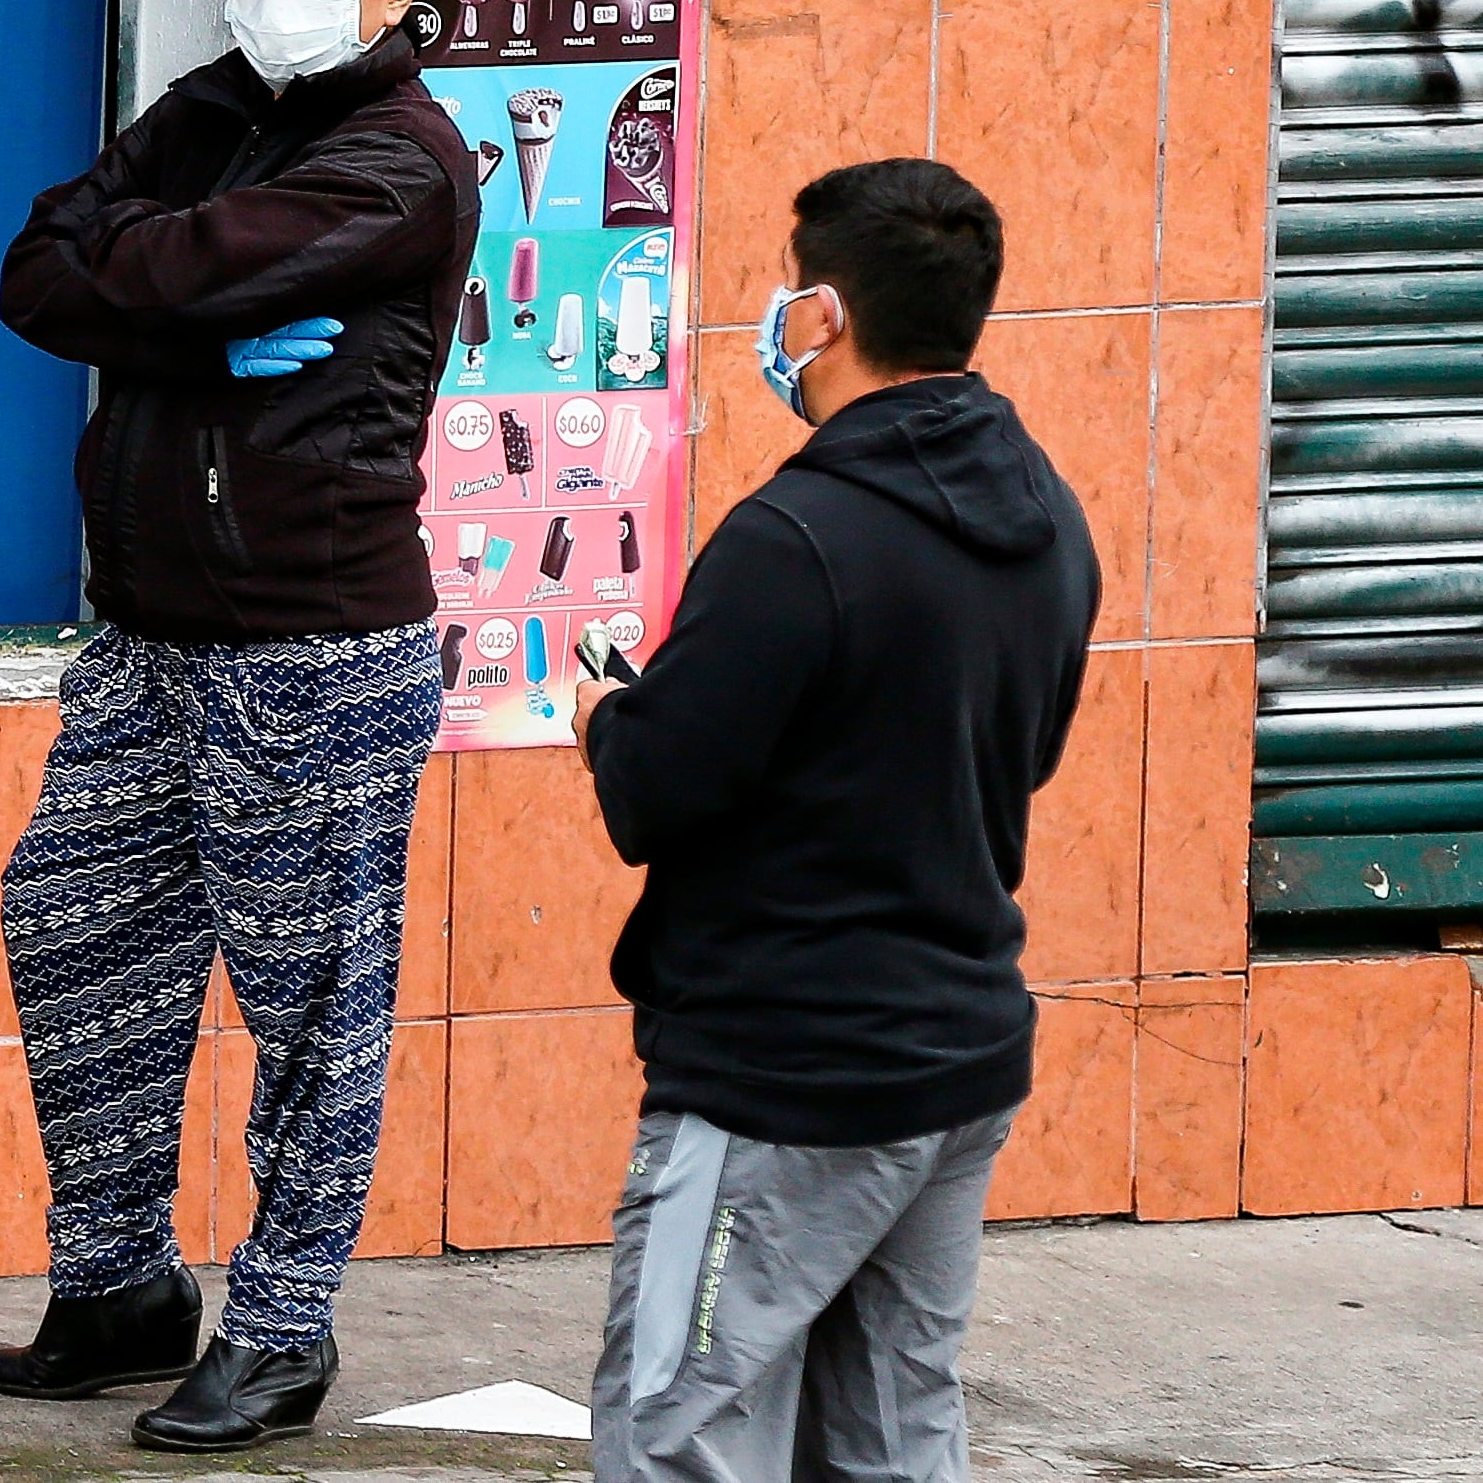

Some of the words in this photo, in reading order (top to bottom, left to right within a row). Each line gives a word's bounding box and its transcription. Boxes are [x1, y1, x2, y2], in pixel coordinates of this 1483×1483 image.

[447, 414, 490, 436] $0.75
[558, 413, 602, 435] $0.60
[478, 632, 515, 649] $0.25
